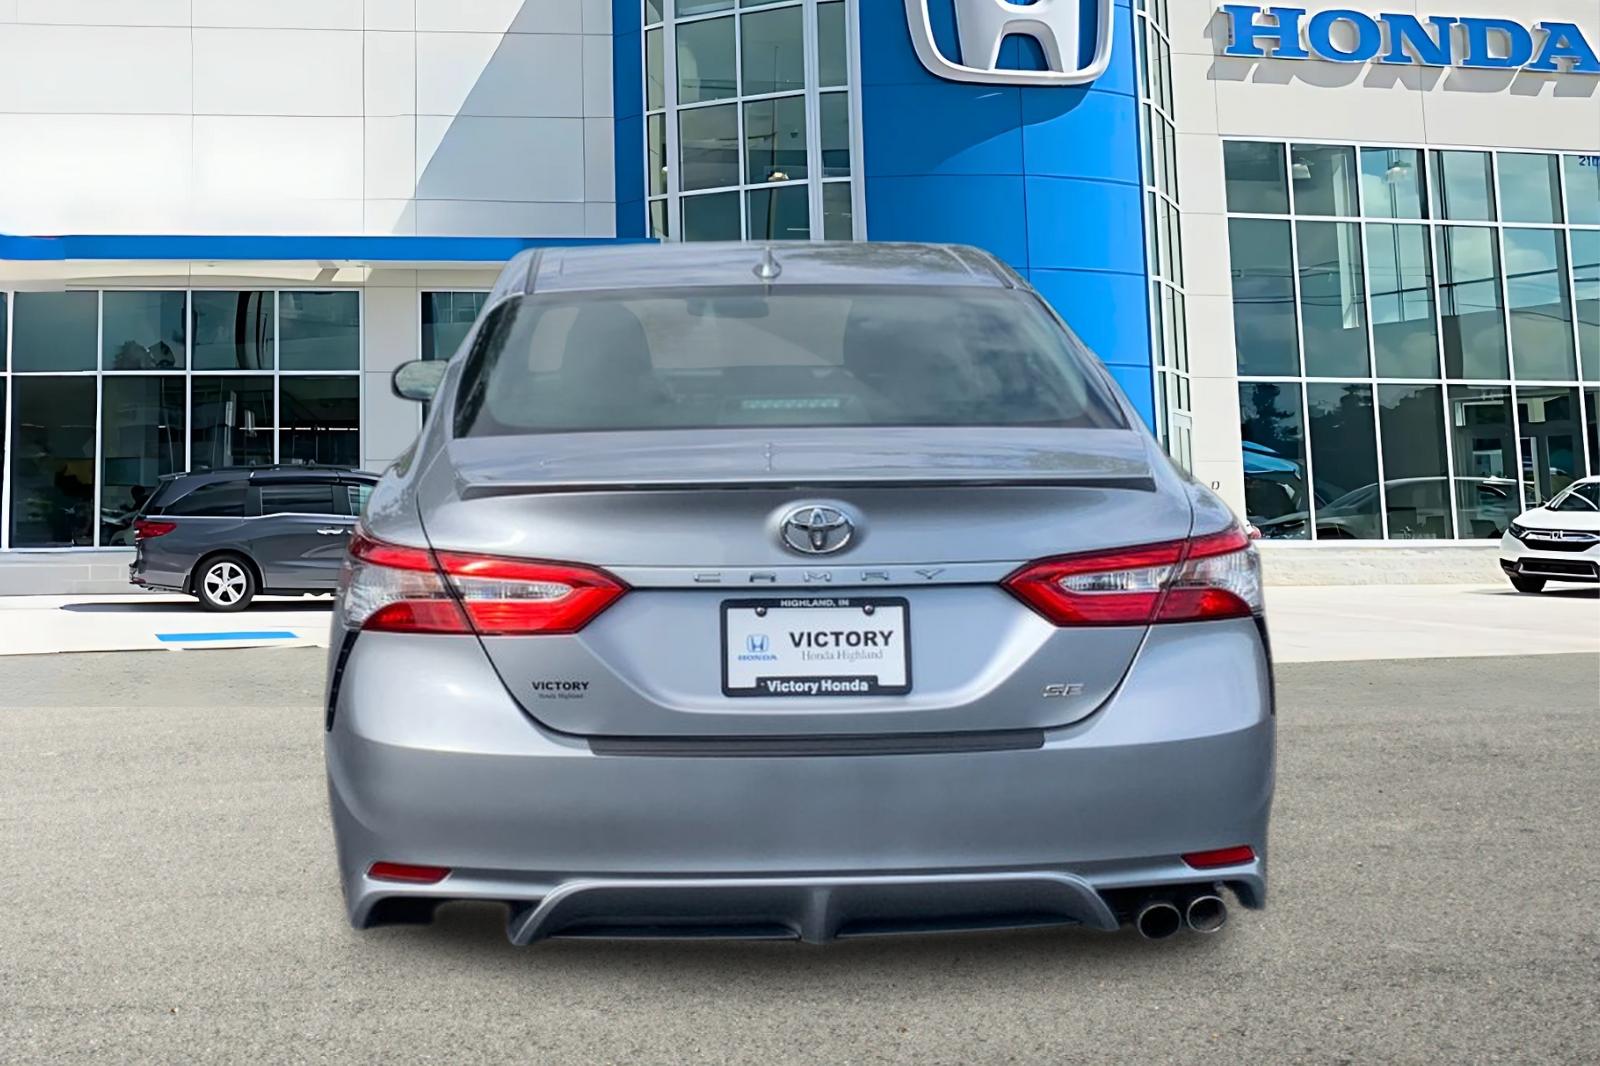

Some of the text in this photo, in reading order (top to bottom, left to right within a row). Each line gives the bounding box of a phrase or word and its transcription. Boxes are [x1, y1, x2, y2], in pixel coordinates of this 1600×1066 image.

[1220, 5, 1600, 74] HONDA
[694, 569, 946, 583] CAMRY
[780, 599, 836, 607] HIGHLAND,
[789, 631, 893, 648] VICTORY
[802, 650, 883, 662] Honda Highland
[531, 681, 590, 690] VICTORY
[767, 680, 868, 694] Victory Honda
[1043, 683, 1084, 696] SE
